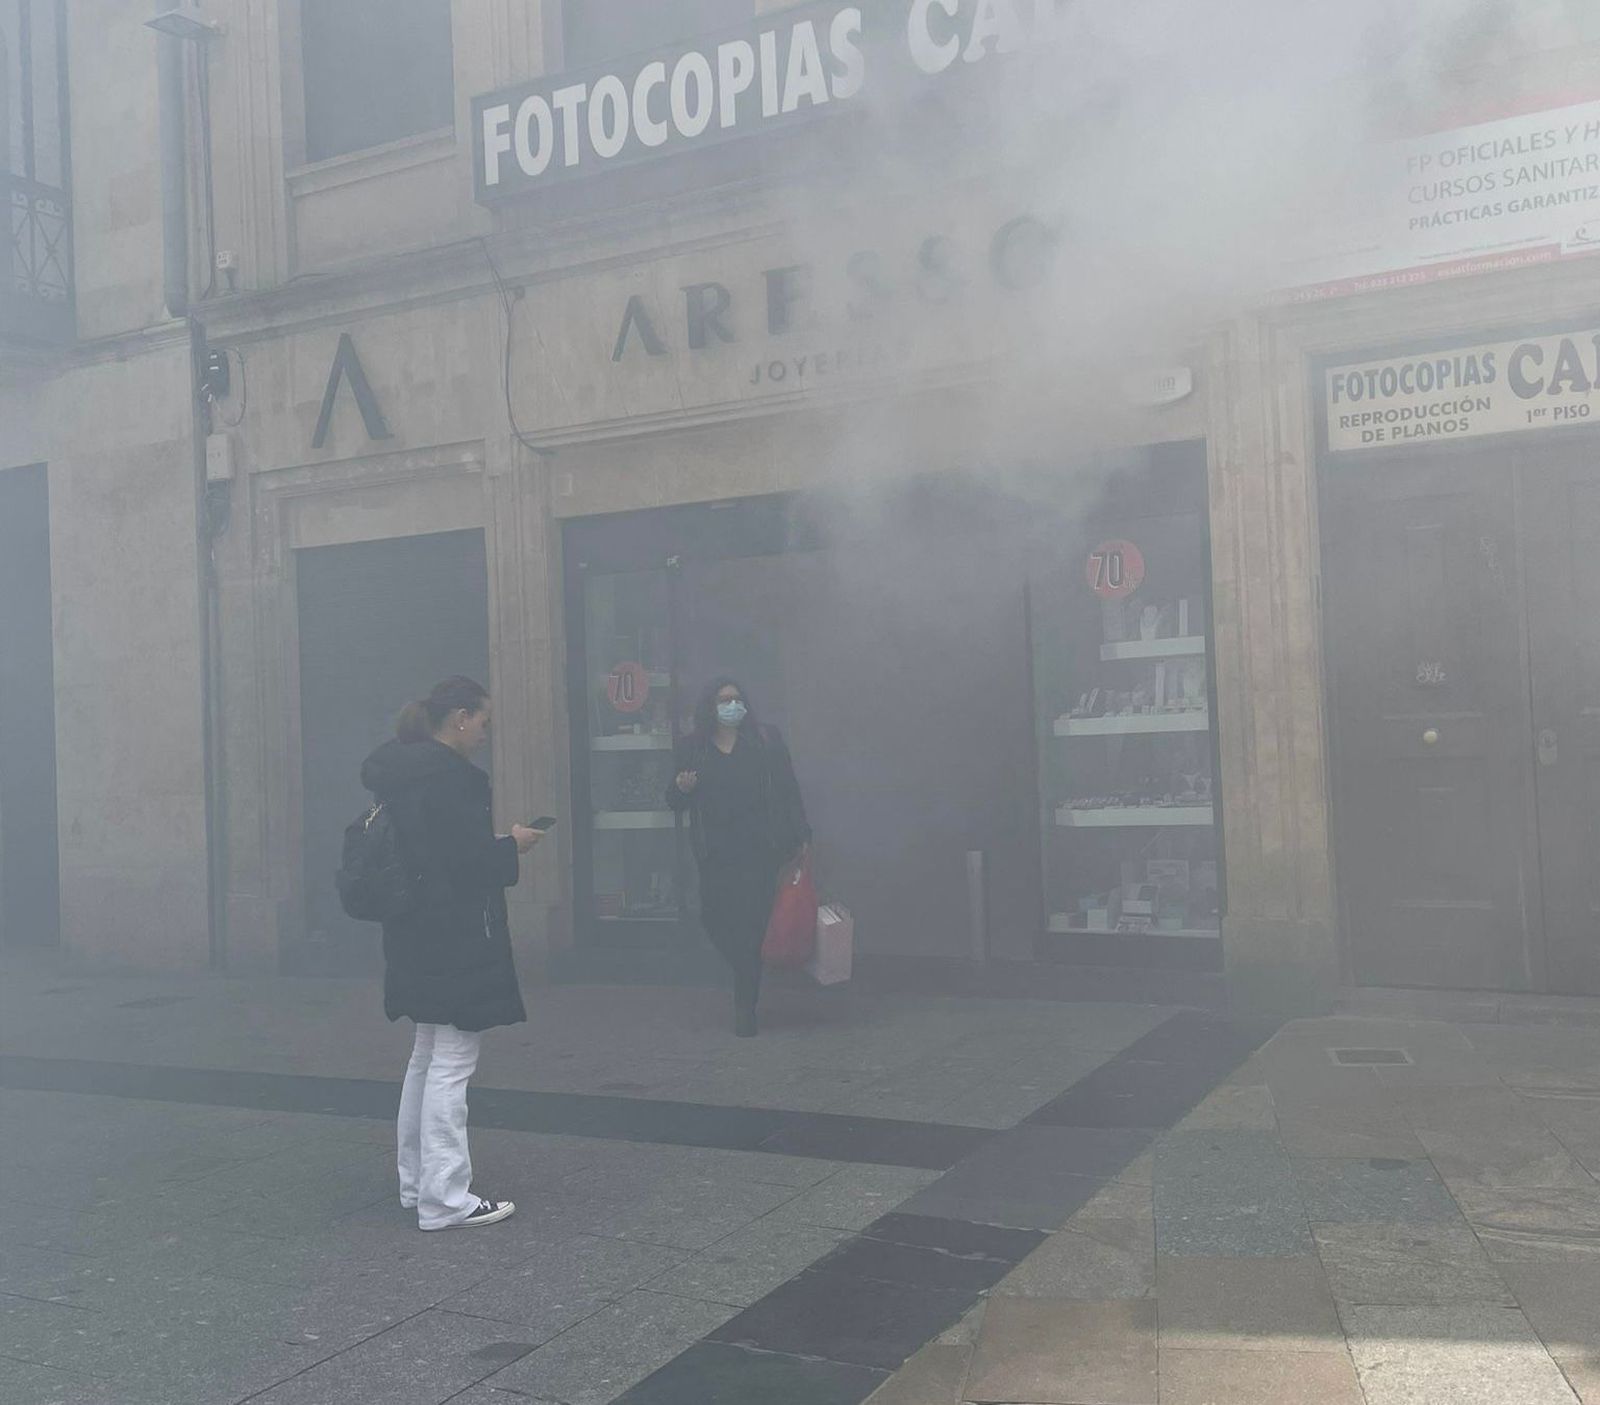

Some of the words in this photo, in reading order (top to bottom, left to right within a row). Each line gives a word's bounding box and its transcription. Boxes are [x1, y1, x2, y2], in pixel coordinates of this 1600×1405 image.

[482, 7, 865, 189] FOTOCOPIAS
[908, 0, 1058, 75] CA
[1406, 153, 1433, 176] FP
[1439, 128, 1557, 168] OFICIALES
[1564, 124, 1579, 145] Y
[1406, 171, 1496, 205] CURSOS
[1502, 152, 1599, 189] SANITAR
[1407, 200, 1503, 232] PRÁCTICAS
[1507, 185, 1600, 214] GARANTIZ
[1331, 351, 1497, 404] FOTOCOPIAS
[1338, 394, 1492, 429] REPRODUCCIÓN
[1361, 427, 1385, 443] DE
[1391, 417, 1470, 440] PLANOS
[1553, 403, 1591, 421] PISO
[1090, 551, 1124, 590] 70
[608, 671, 635, 704] 70
